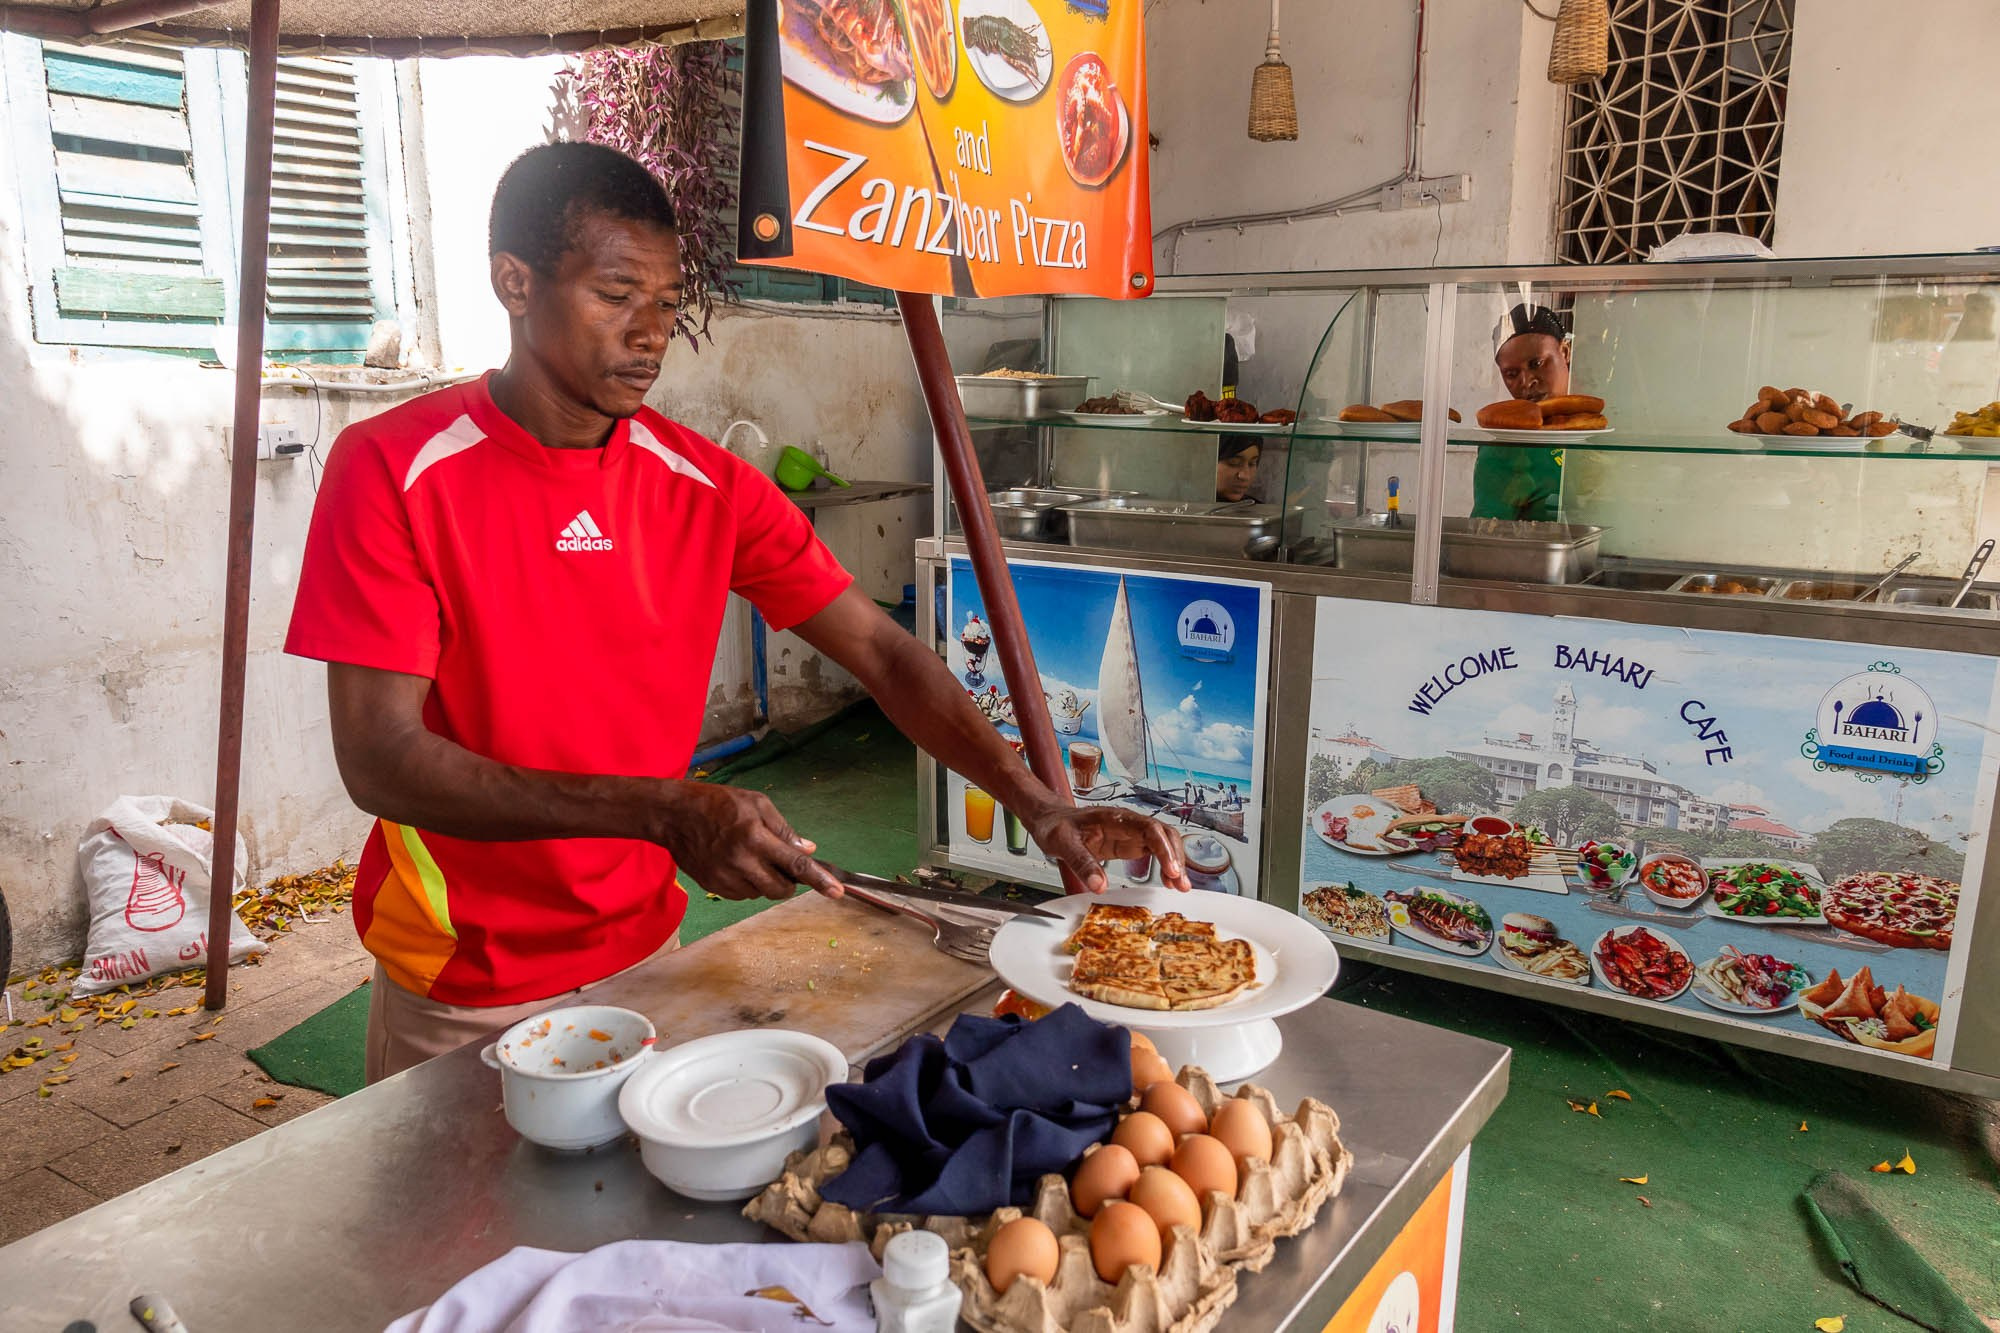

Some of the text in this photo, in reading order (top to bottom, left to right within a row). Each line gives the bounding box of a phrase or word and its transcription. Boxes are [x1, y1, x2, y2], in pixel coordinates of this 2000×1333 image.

[954, 120, 992, 175] and
[792, 140, 1087, 270] Zanzibar Pizza
[556, 537, 613, 551] adidas
[1190, 633, 1222, 642] BAHARI
[1408, 644, 1734, 766] WELCOME BAHARI CAFE
[1843, 725, 1907, 742] BAHARI
[1829, 749, 1914, 767] Food and Drinks
[90, 947, 150, 982] OMAN
